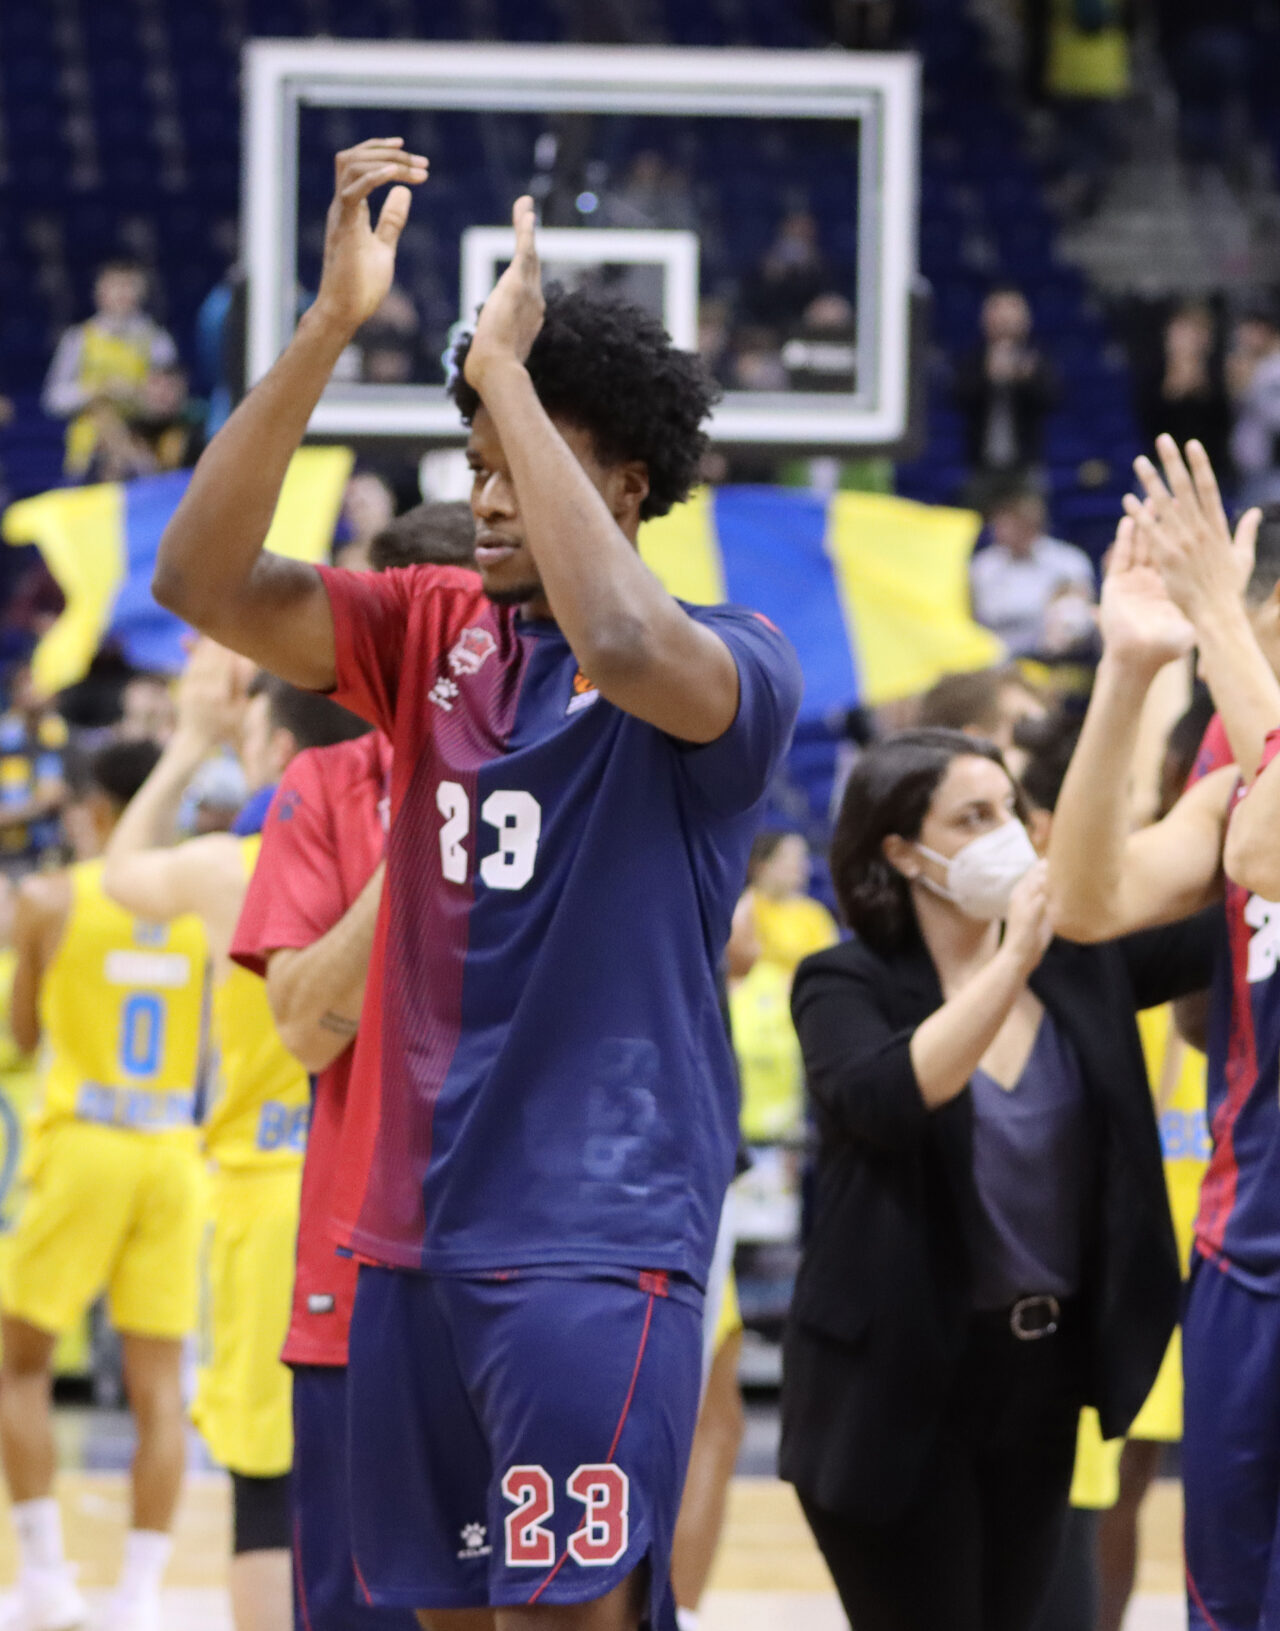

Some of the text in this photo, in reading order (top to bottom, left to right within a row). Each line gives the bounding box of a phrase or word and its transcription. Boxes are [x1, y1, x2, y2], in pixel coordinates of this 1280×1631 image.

[436, 780, 542, 891] 23
[119, 992, 165, 1078] 0
[501, 1463, 630, 1568] 23
